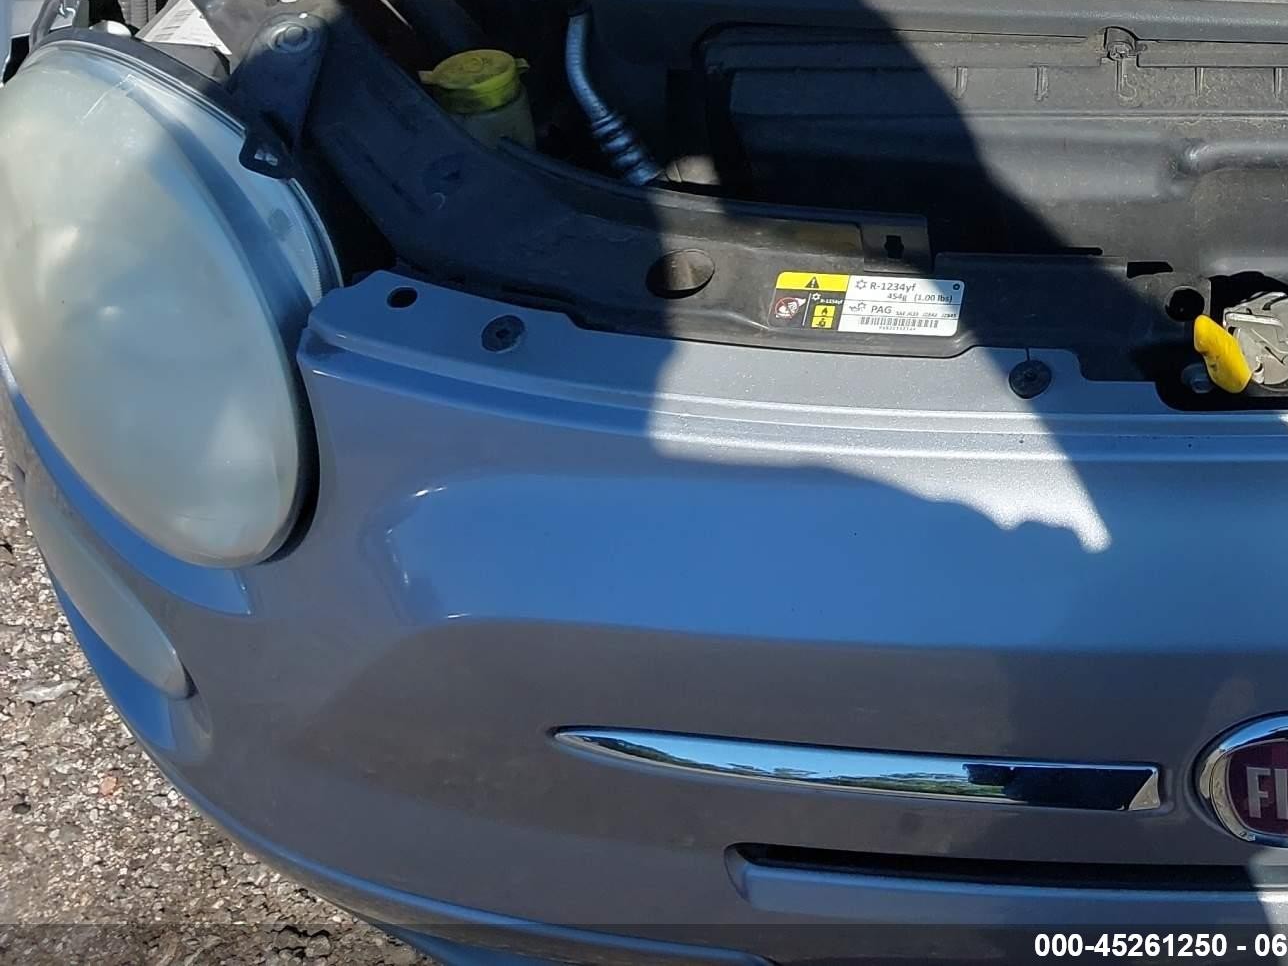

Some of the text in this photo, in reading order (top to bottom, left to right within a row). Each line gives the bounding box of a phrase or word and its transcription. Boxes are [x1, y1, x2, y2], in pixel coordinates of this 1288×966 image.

[870, 282, 916, 293] R-1234yf
[887, 293, 953, 303] 454g (1.00 lbs)
[870, 305, 893, 314] PAG
